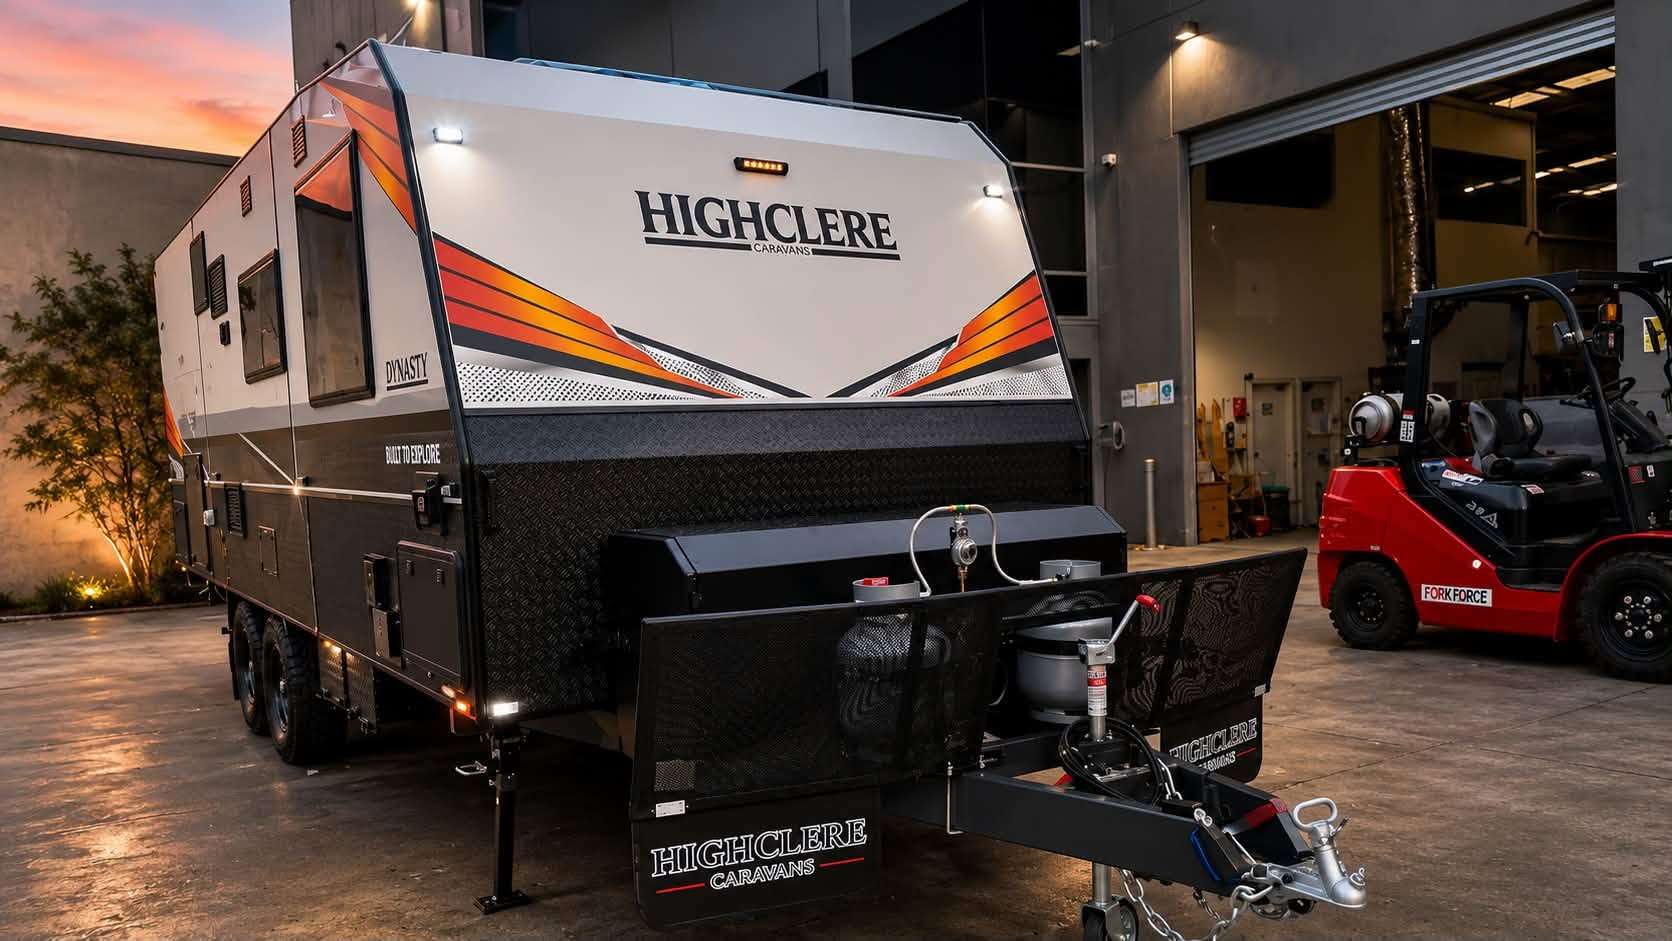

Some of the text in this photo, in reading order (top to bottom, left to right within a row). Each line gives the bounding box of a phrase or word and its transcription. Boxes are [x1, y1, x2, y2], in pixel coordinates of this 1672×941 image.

[634, 190, 898, 251] HIGHCLERE
[753, 243, 811, 256] CARAVANS
[386, 352, 428, 383] DYNASTY
[402, 446, 411, 465] TO
[411, 444, 441, 465] EXPLORE
[651, 817, 868, 877] HIGHCLERE
[710, 858, 815, 889] CARAVANS
